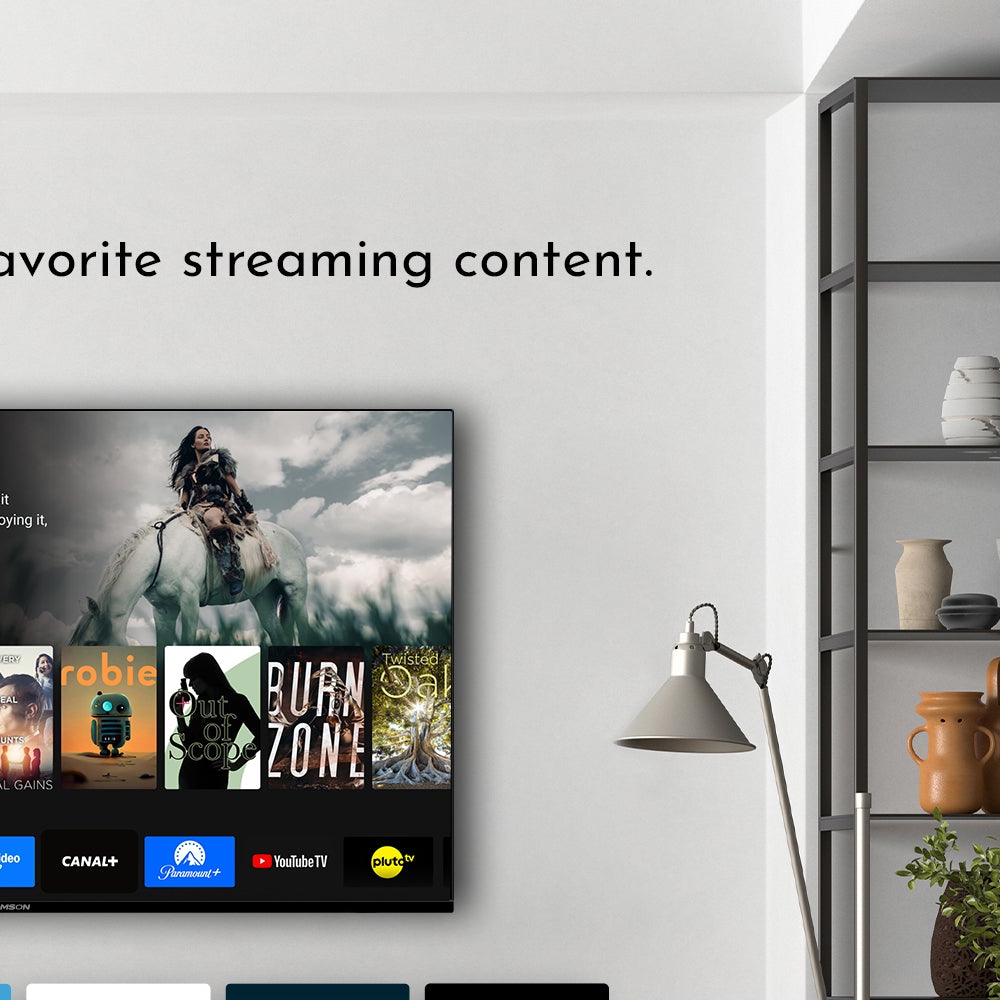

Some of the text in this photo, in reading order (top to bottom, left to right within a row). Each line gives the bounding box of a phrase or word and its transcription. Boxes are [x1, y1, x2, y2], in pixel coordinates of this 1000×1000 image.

[2, 493, 8, 505] it
[37, 514, 47, 528] it,
[382, 653, 438, 665] Twisted
[61, 652, 157, 687] robie
[268, 662, 364, 716] BURN
[169, 689, 229, 718] Out
[203, 713, 237, 741] of
[168, 732, 257, 770] Scope
[268, 722, 364, 777] ZONE
[14, 780, 53, 791] GAINS
[62, 855, 119, 868] CANAL+
[274, 855, 328, 868] YouTube TV
[158, 864, 221, 880] Paramount+
